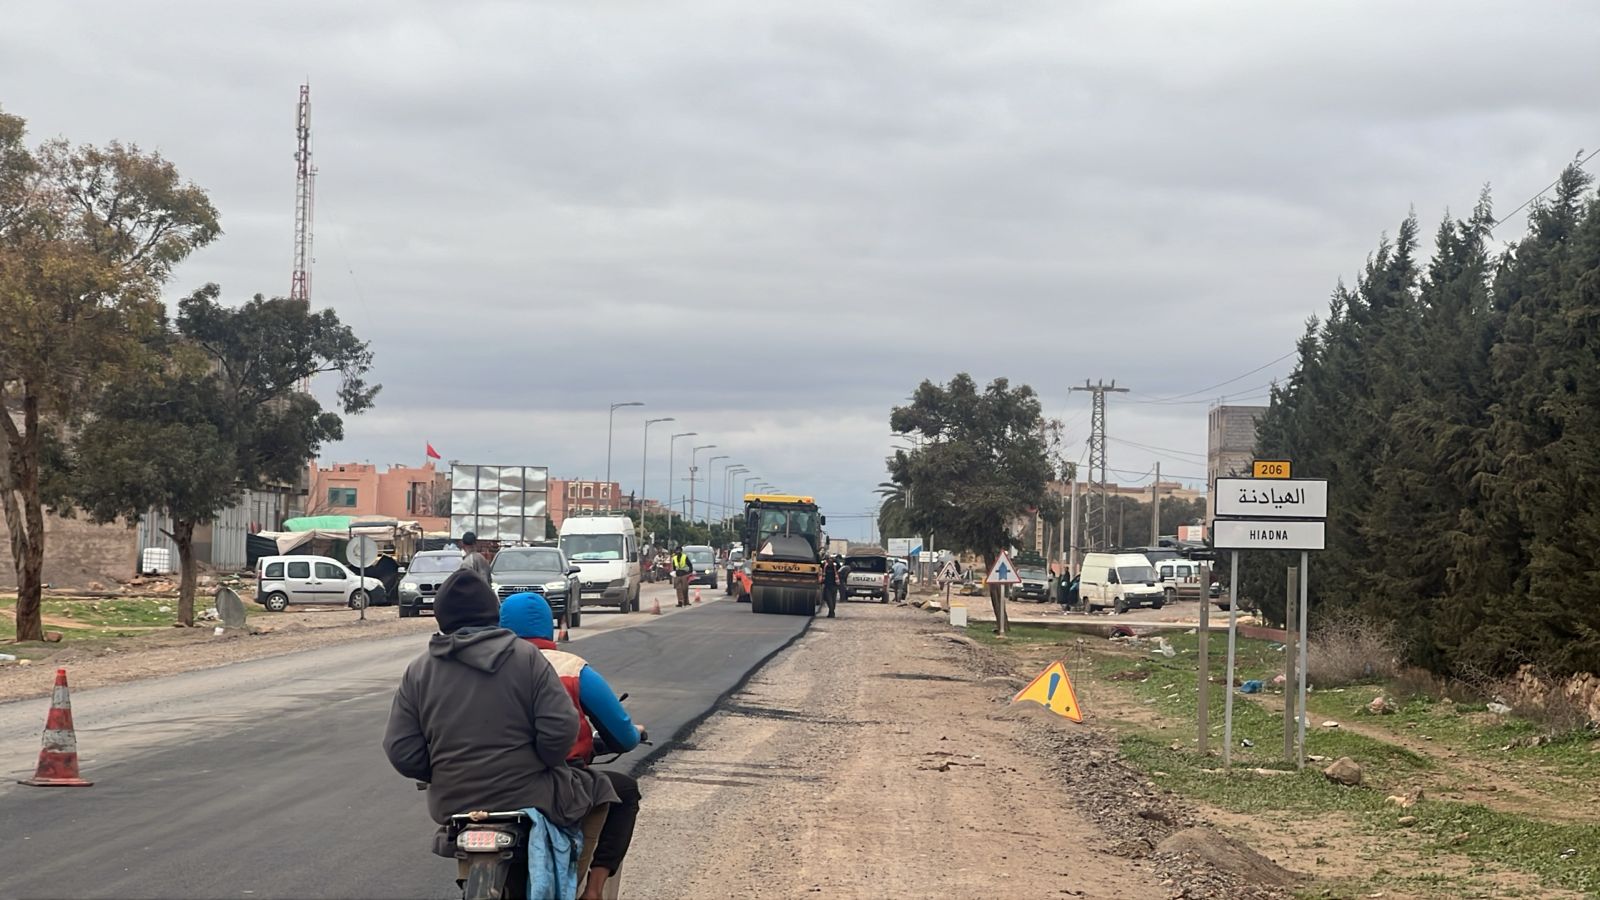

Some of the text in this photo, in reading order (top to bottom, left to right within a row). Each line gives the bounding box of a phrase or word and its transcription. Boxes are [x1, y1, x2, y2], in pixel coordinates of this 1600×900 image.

[1262, 464, 1282, 474] 206
[1238, 488, 1305, 508] الهيادنة
[1250, 530, 1288, 540] HIADNA
